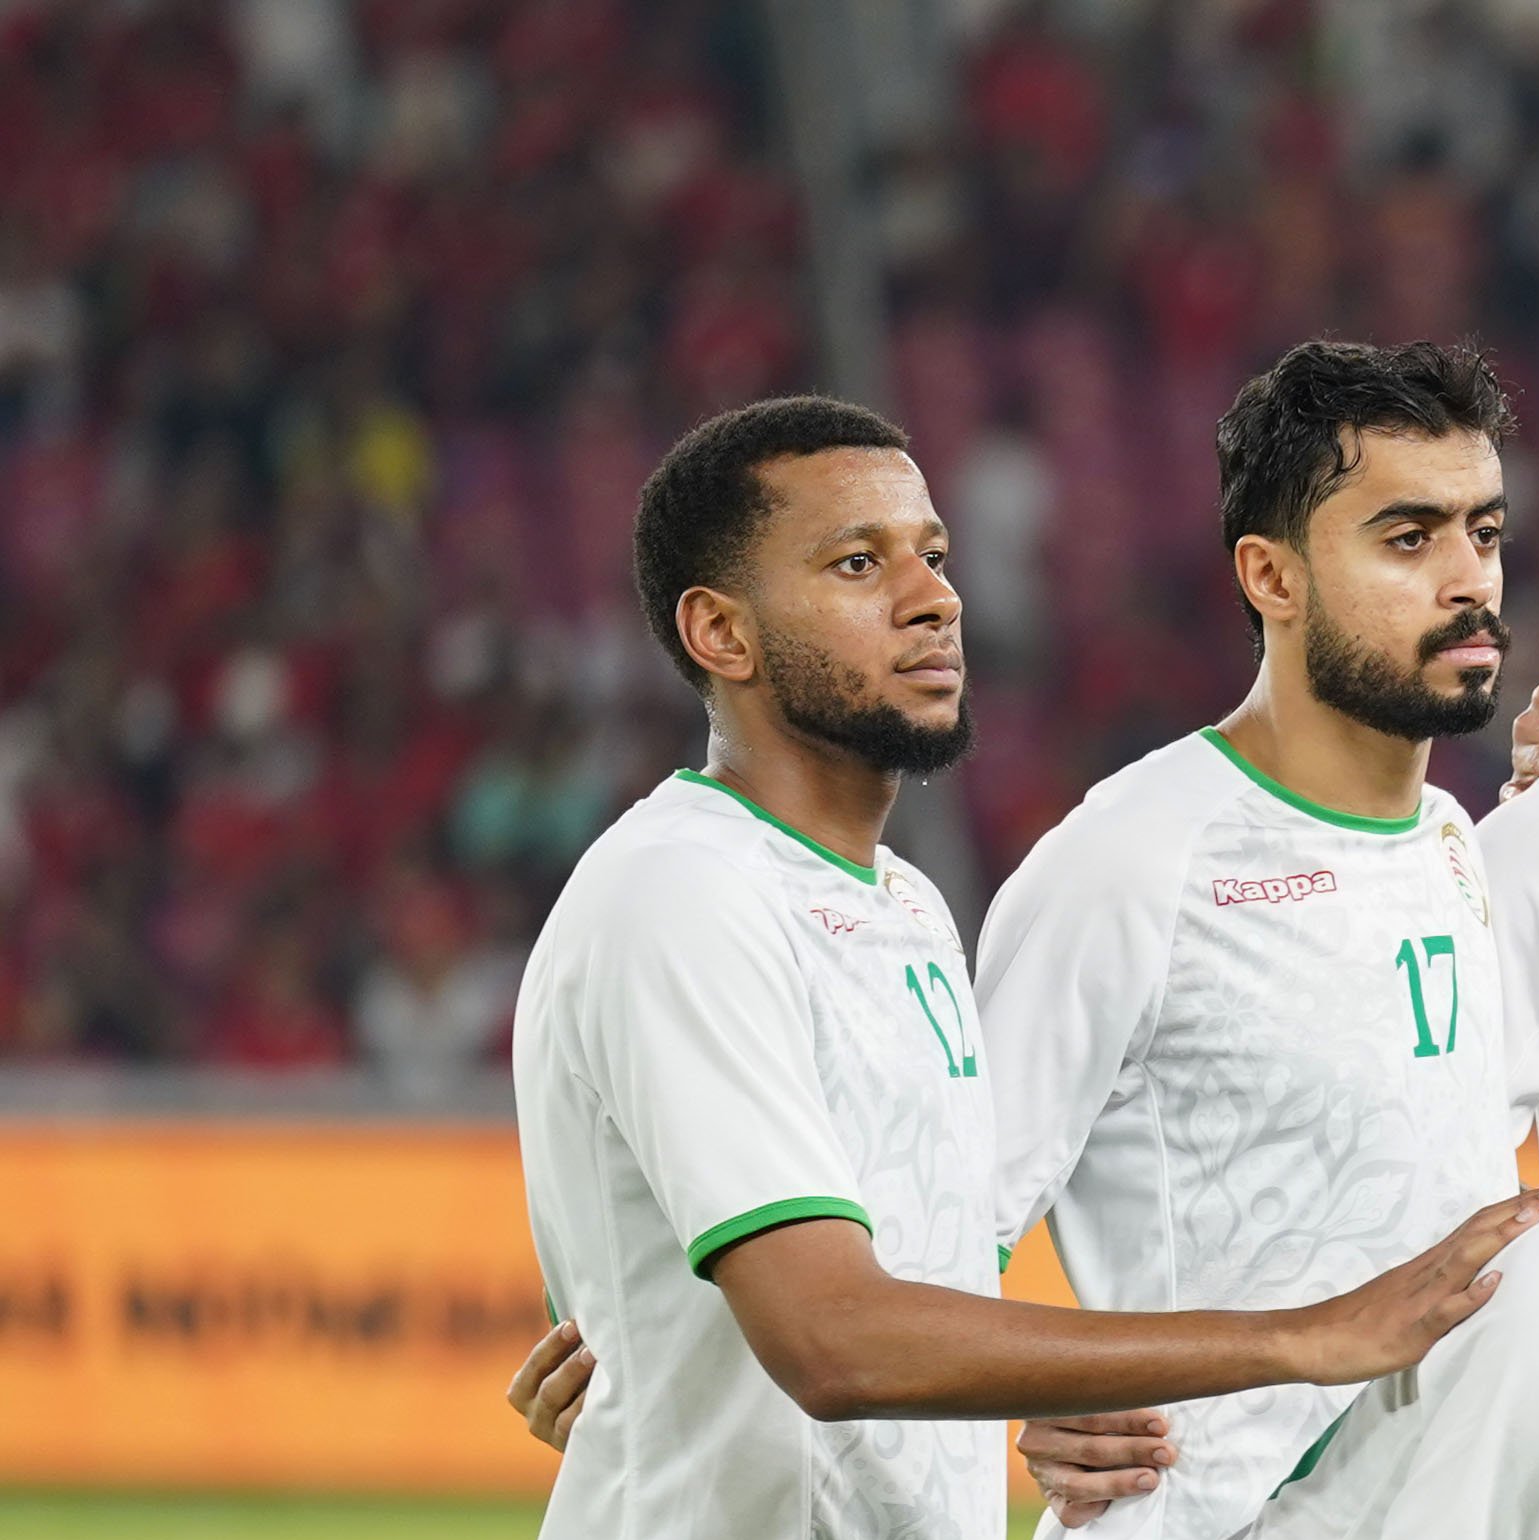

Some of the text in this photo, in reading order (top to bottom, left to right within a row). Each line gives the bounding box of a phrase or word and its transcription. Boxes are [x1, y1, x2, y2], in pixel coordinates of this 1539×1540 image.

[1212, 869, 1337, 907] Kappa
[904, 961, 978, 1078] 12
[1394, 934, 1459, 1059] 17
